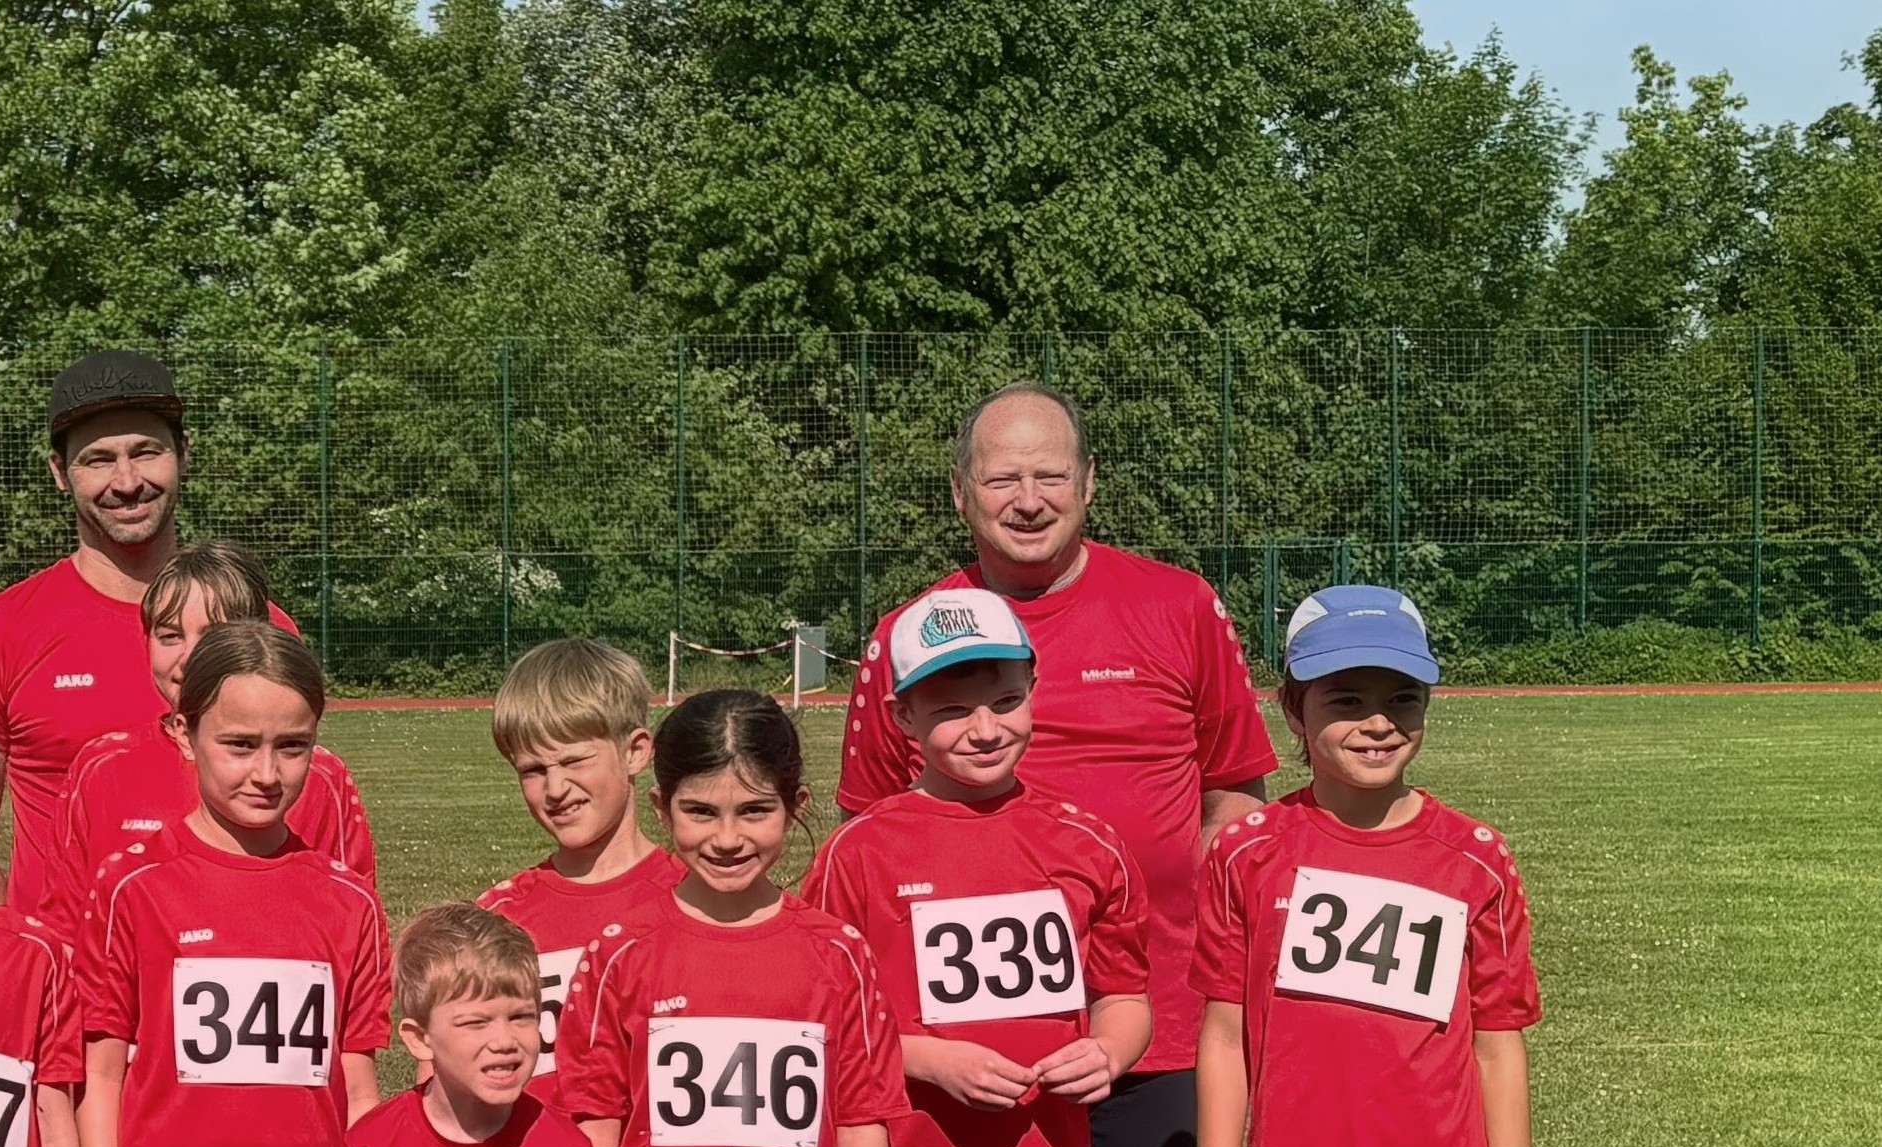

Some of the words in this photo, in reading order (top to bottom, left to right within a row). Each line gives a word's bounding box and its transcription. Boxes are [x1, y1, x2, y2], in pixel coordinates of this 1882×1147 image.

[54, 674, 94, 689] JAKO
[897, 883, 934, 897] JAKO
[179, 929, 213, 943] JAKO
[925, 911, 1075, 1004] 339
[1290, 893, 1444, 997] 341
[182, 981, 329, 1066] 344
[653, 996, 687, 1013] JAKO
[656, 1041, 818, 1131] 346
